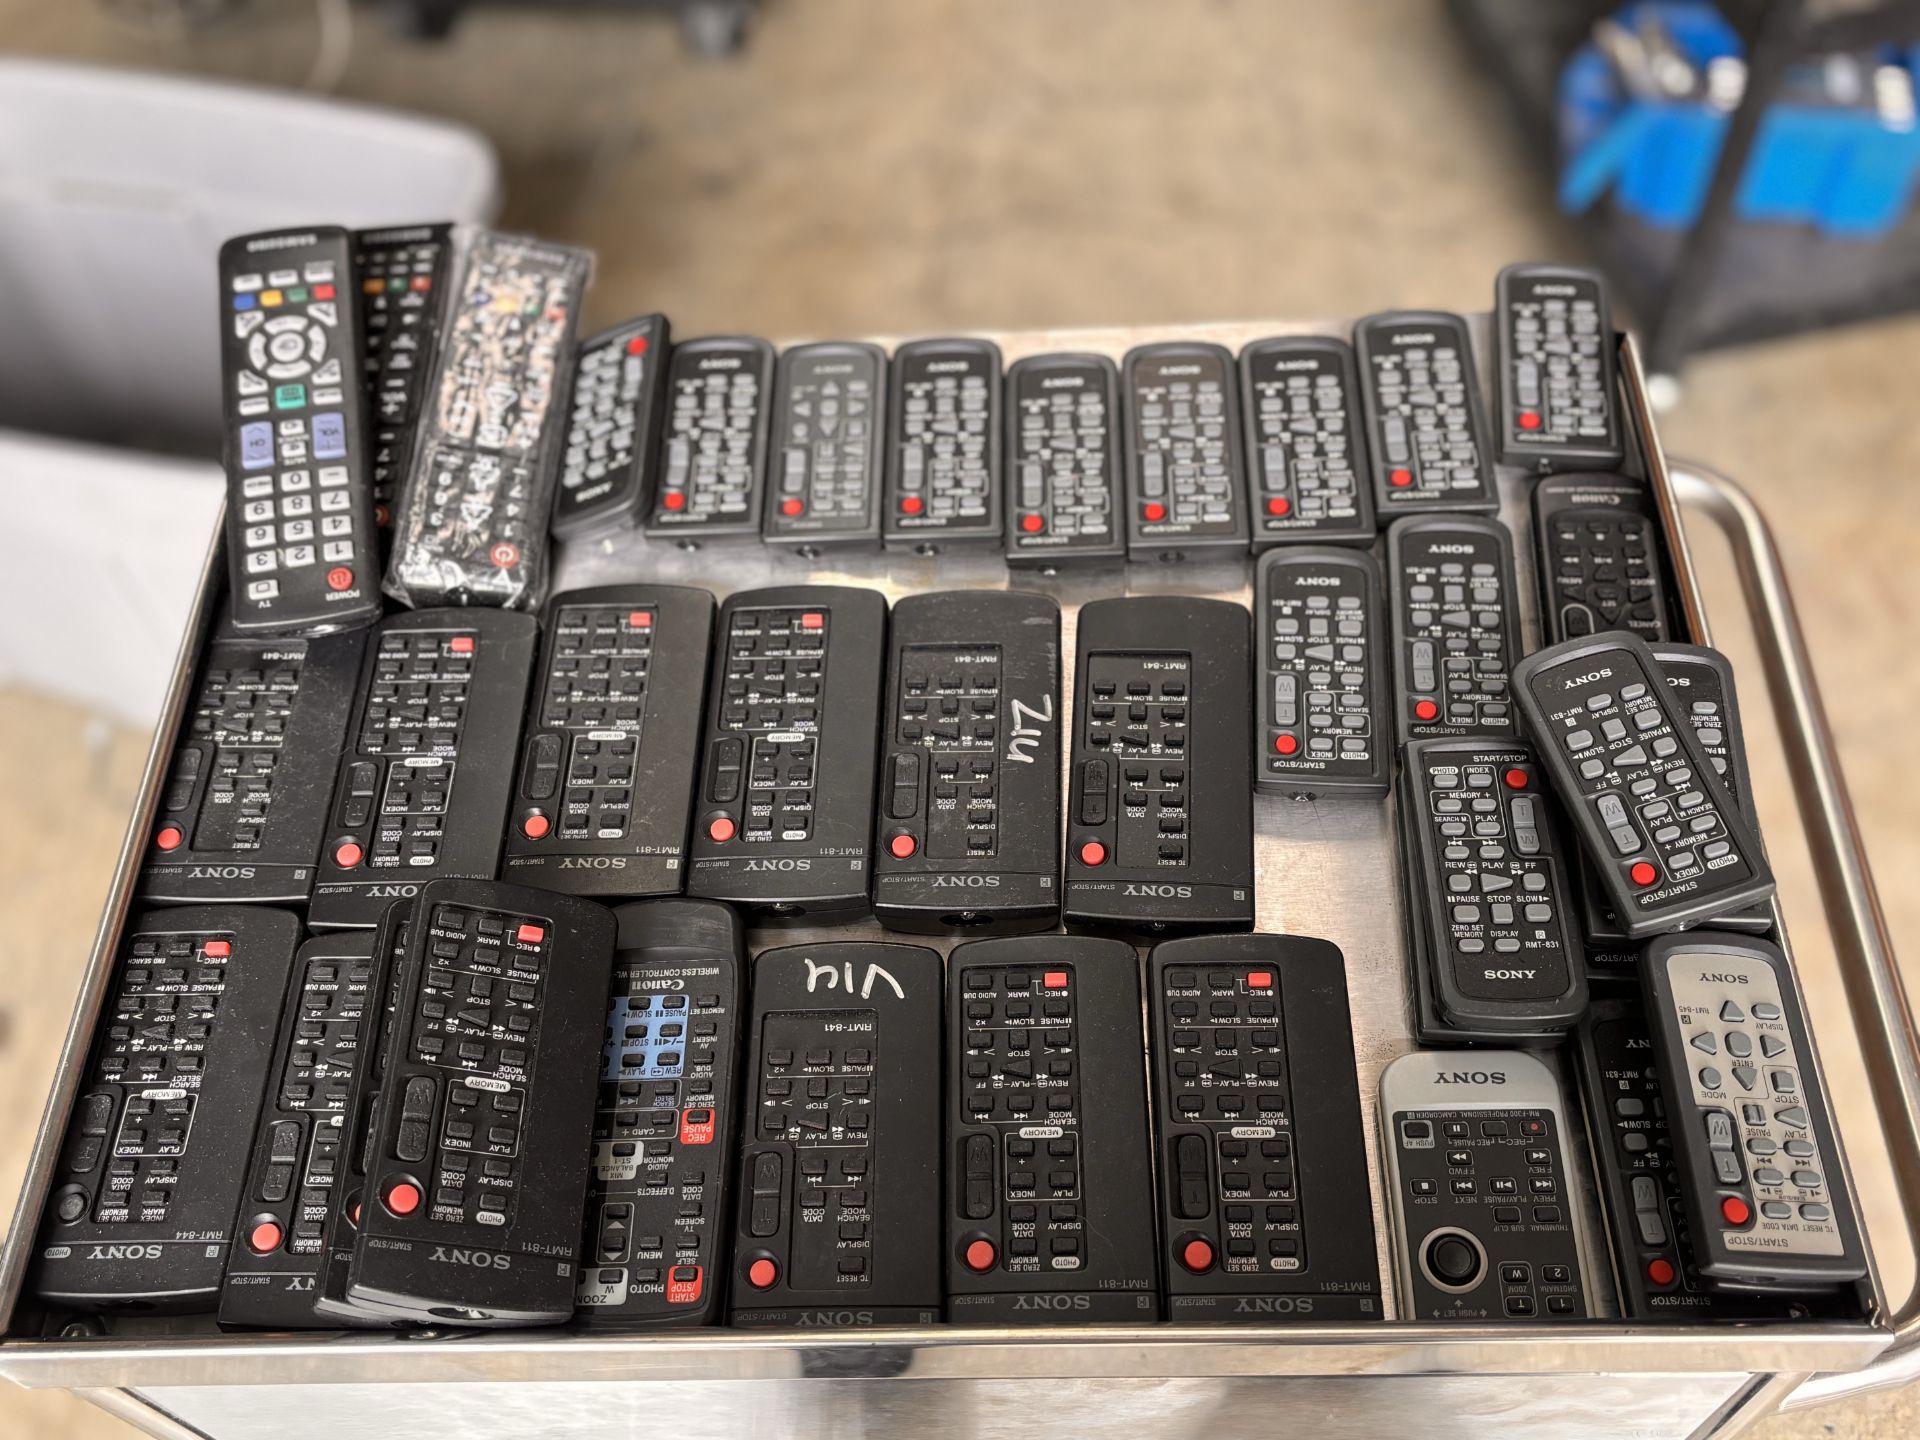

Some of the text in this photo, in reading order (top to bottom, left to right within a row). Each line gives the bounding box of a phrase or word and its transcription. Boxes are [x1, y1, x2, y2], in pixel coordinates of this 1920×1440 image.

[1571, 493, 1620, 504] Canon
[1428, 544, 1474, 554] SONY
[1296, 576, 1340, 586] SONY
[326, 589, 360, 600] POWER
[258, 600, 272, 608] TV
[262, 651, 305, 660] RMT-841
[955, 655, 997, 663] RMT-841
[1143, 662, 1186, 670] RMT-841
[1564, 668, 1612, 689] SONY
[1550, 706, 1582, 721] RMT-831
[1413, 726, 1466, 734] START/STOP
[1637, 728, 1663, 740] PAUSE
[1608, 737, 1633, 750] STOP
[1473, 754, 1527, 762] START/STOP
[1273, 760, 1325, 769] START/STOP
[1673, 832, 1707, 848] MEMORY
[636, 846, 680, 854] RMT-811
[819, 847, 863, 855] RMT-811
[558, 856, 627, 869] SONY
[743, 858, 811, 871] SONY
[1709, 856, 1735, 868] PHOTO
[188, 866, 256, 879] SONY
[1674, 866, 1700, 879] INDEX
[932, 874, 1000, 887] SONY
[365, 884, 418, 897] ONY
[1122, 883, 1192, 898] SONY
[1640, 881, 1698, 904] START/STOP
[446, 931, 467, 939] AUDIO
[476, 936, 500, 945] MARK
[1525, 940, 1559, 948] RMT-831
[507, 968, 533, 978] PAUSE
[630, 967, 720, 978] WIRELESS CONTROLLER
[1484, 969, 1536, 980] SONY
[1699, 972, 1749, 984] SONY
[631, 979, 684, 991] Canon
[466, 995, 491, 1005] STOP
[630, 1009, 652, 1019] SLOW
[665, 1009, 687, 1017] PAUSE
[701, 1007, 725, 1015] REMOTE
[1678, 1006, 1709, 1014] RMT-845
[824, 1023, 872, 1032] RMT-841
[1755, 1022, 1783, 1030] DISPLAY
[630, 1039, 649, 1047] STOP
[692, 1035, 718, 1044] INSERT
[1215, 1048, 1238, 1056] STOP
[664, 1066, 682, 1075] REW
[1605, 1070, 1638, 1078] RMT-831
[1433, 1072, 1506, 1084] SONY
[469, 1077, 507, 1090] MEMORY
[685, 1094, 714, 1102] MEMORY
[1701, 1090, 1727, 1099] MODE
[1774, 1095, 1799, 1103] STOP
[631, 1128, 655, 1136] CARD
[683, 1125, 711, 1133] PAUSE
[1023, 1128, 1060, 1137] MEMORY
[1235, 1128, 1272, 1137] MEMORY
[1746, 1127, 1771, 1137] PAUSE
[1784, 1129, 1807, 1138] PLAY
[687, 1133, 706, 1142] REC
[444, 1138, 472, 1148] INDEX
[643, 1156, 674, 1164] MONITOR
[145, 1176, 178, 1184] DISPLAY
[441, 1171, 466, 1180] CODE
[441, 1179, 463, 1187] DATA
[477, 1176, 513, 1187] DISPLAY
[637, 1188, 675, 1196] D.EFFECTS
[1224, 1190, 1251, 1198] INDEX
[433, 1205, 464, 1214] MEMORY
[431, 1212, 464, 1222] ZERO SET
[479, 1214, 503, 1222] PHOTO
[674, 1218, 705, 1226] SCREEN
[1047, 1222, 1082, 1230] DISPLAY
[1265, 1222, 1299, 1231] DISPLAY
[1781, 1223, 1798, 1231] DATA
[175, 1230, 223, 1240] RMT-844
[368, 1240, 412, 1250] START/STOP
[836, 1240, 870, 1248] DISPLAY
[1727, 1236, 1788, 1247] START/STOP
[87, 1245, 163, 1259] SONY
[521, 1242, 573, 1256] RMT-811
[429, 1247, 511, 1270] SONY
[636, 1251, 663, 1260] MENU
[675, 1250, 699, 1258] TIMER
[1512, 1269, 1522, 1277] W
[670, 1283, 697, 1292] /STOP
[1098, 1279, 1149, 1288] RMT-811
[1320, 1282, 1371, 1291] RMT-811
[604, 1285, 614, 1294] W
[630, 1284, 664, 1293] PHOTO
[670, 1292, 695, 1302] START
[1651, 1296, 1711, 1306] START/STOP
[1012, 1295, 1091, 1309] SONY
[1234, 1297, 1314, 1312] SONY
[795, 1311, 874, 1325] SONY
